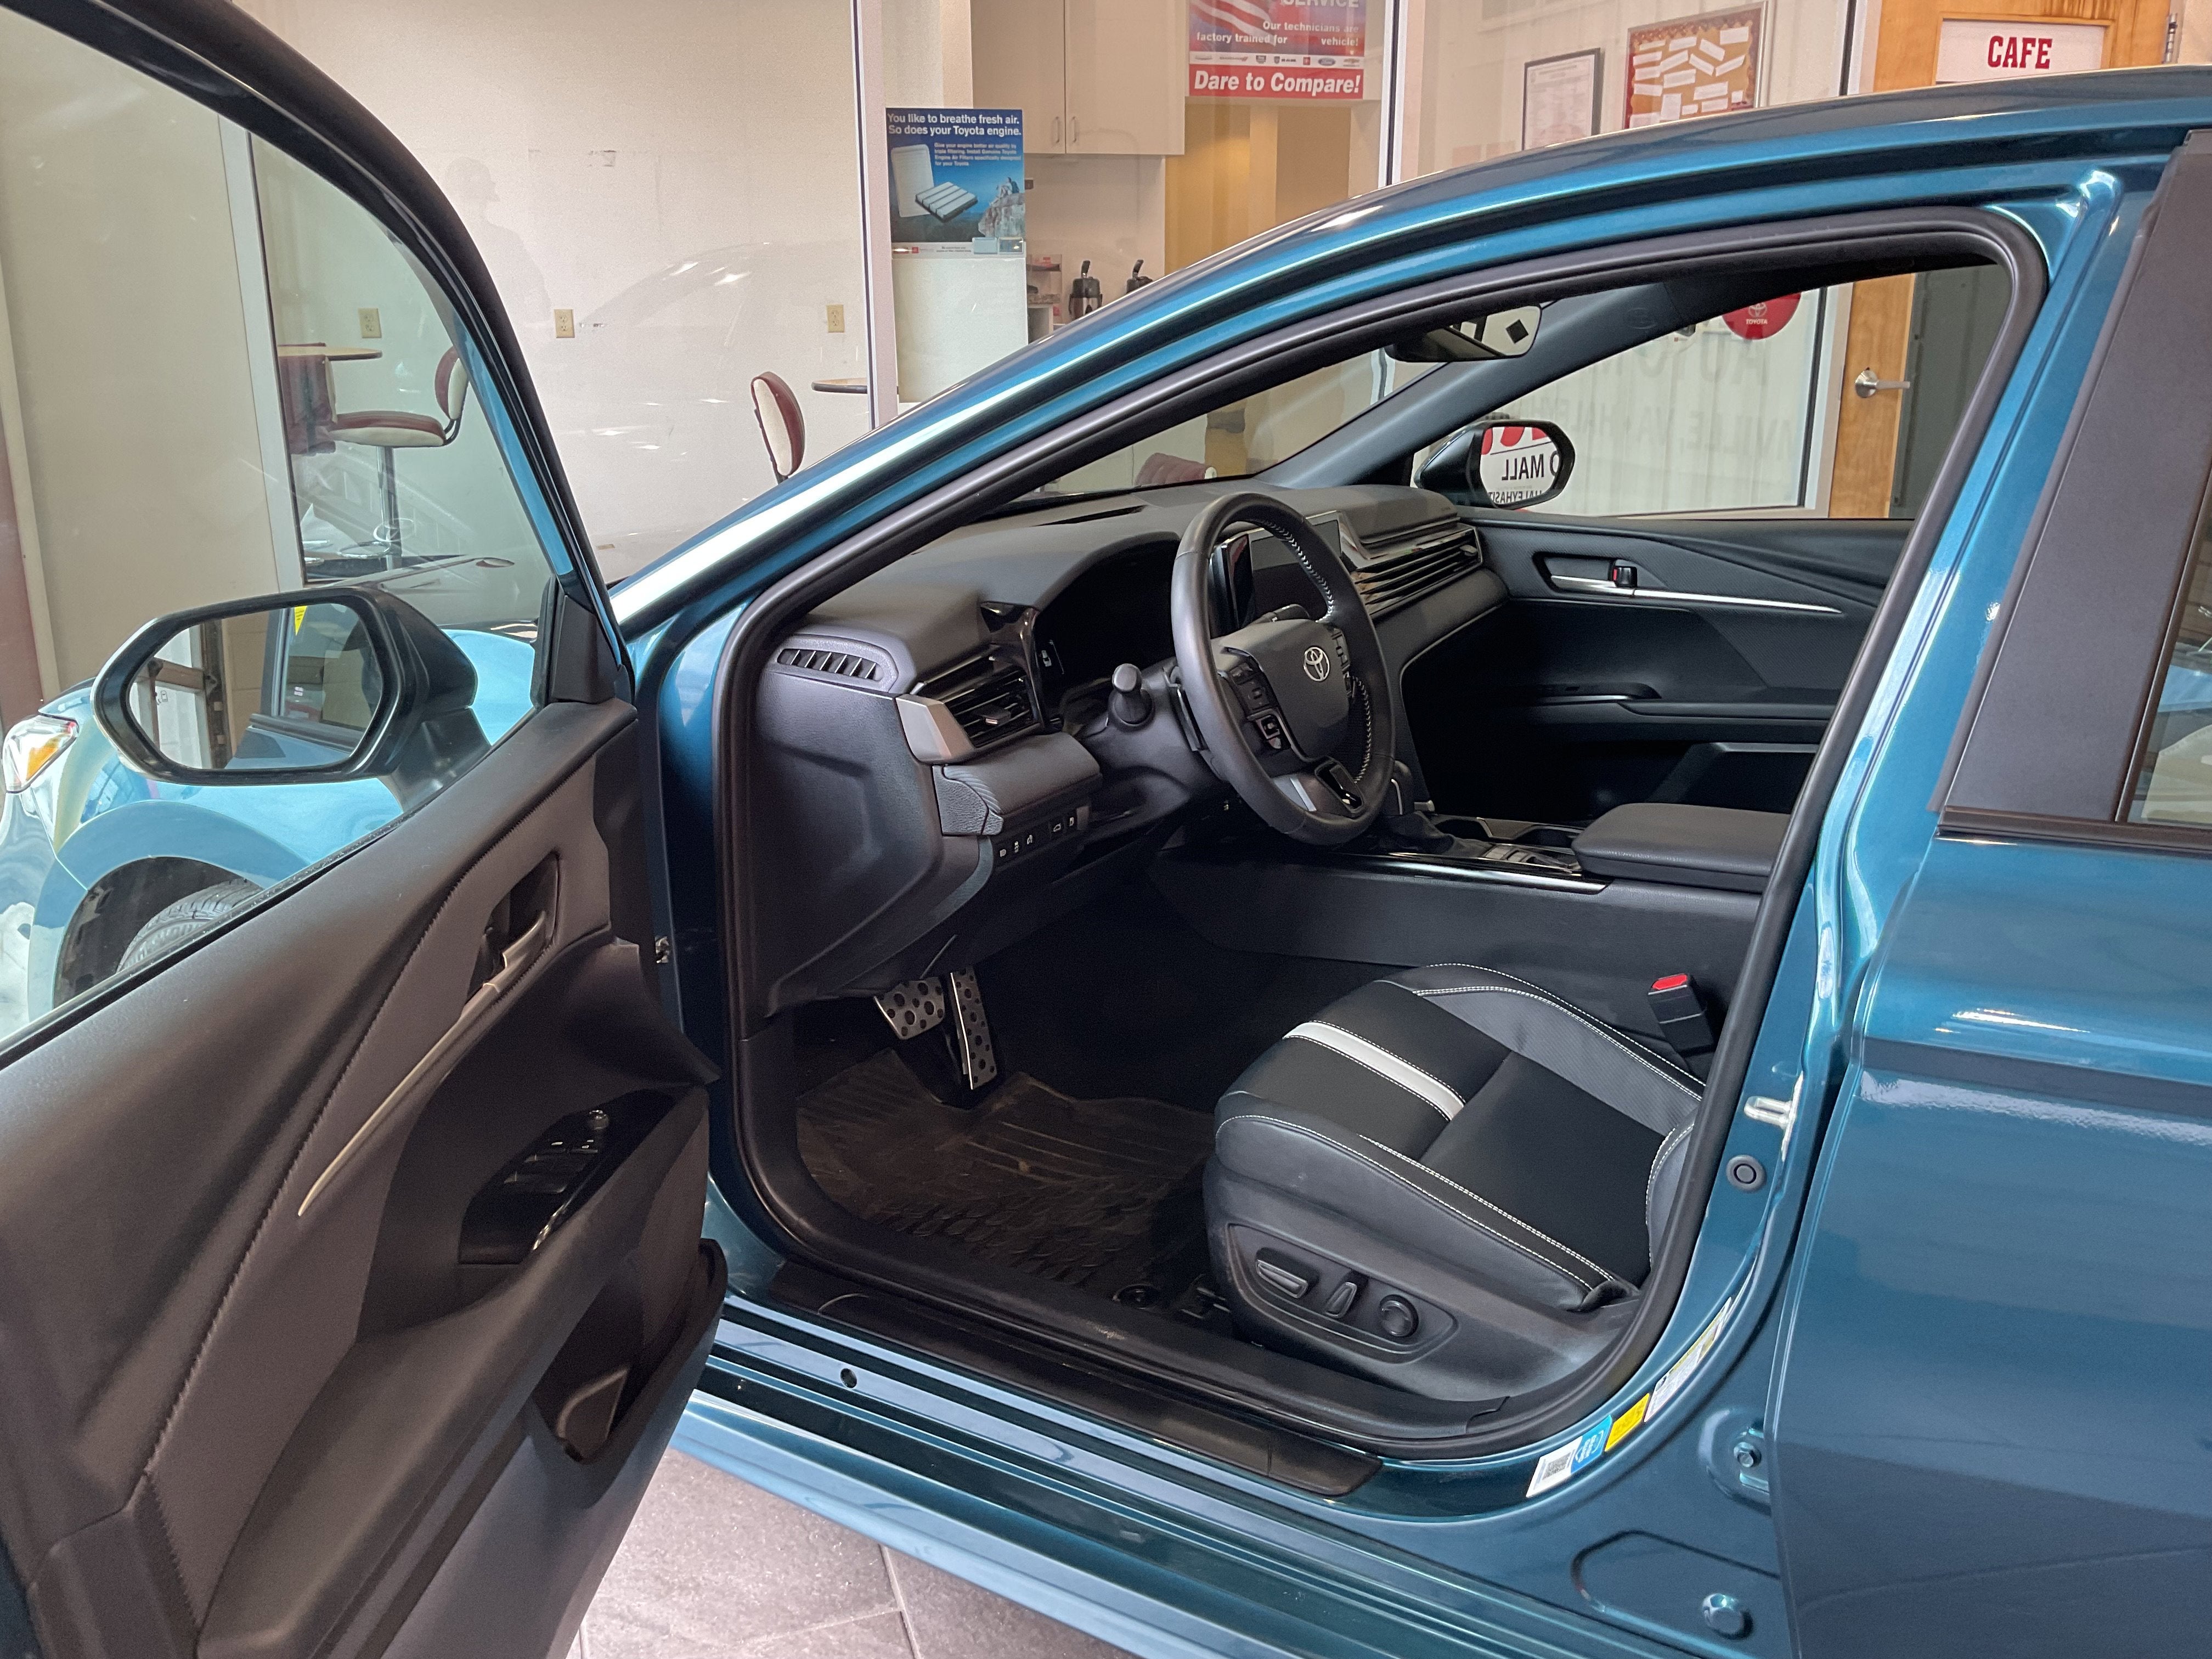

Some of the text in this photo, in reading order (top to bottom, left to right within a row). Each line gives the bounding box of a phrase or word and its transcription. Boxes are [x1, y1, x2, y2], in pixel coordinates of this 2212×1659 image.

[1263, 21, 1281, 30] Our
[1284, 22, 1340, 32] technicians
[1197, 32, 1358, 46] factory trained for vehicle!
[1988, 36, 2053, 70] CAFE
[1194, 70, 1361, 97] Dare to Compare!
[887, 113, 1020, 124] You like to breathe fresh air.
[888, 124, 1022, 137] So does your Toyota engine.
